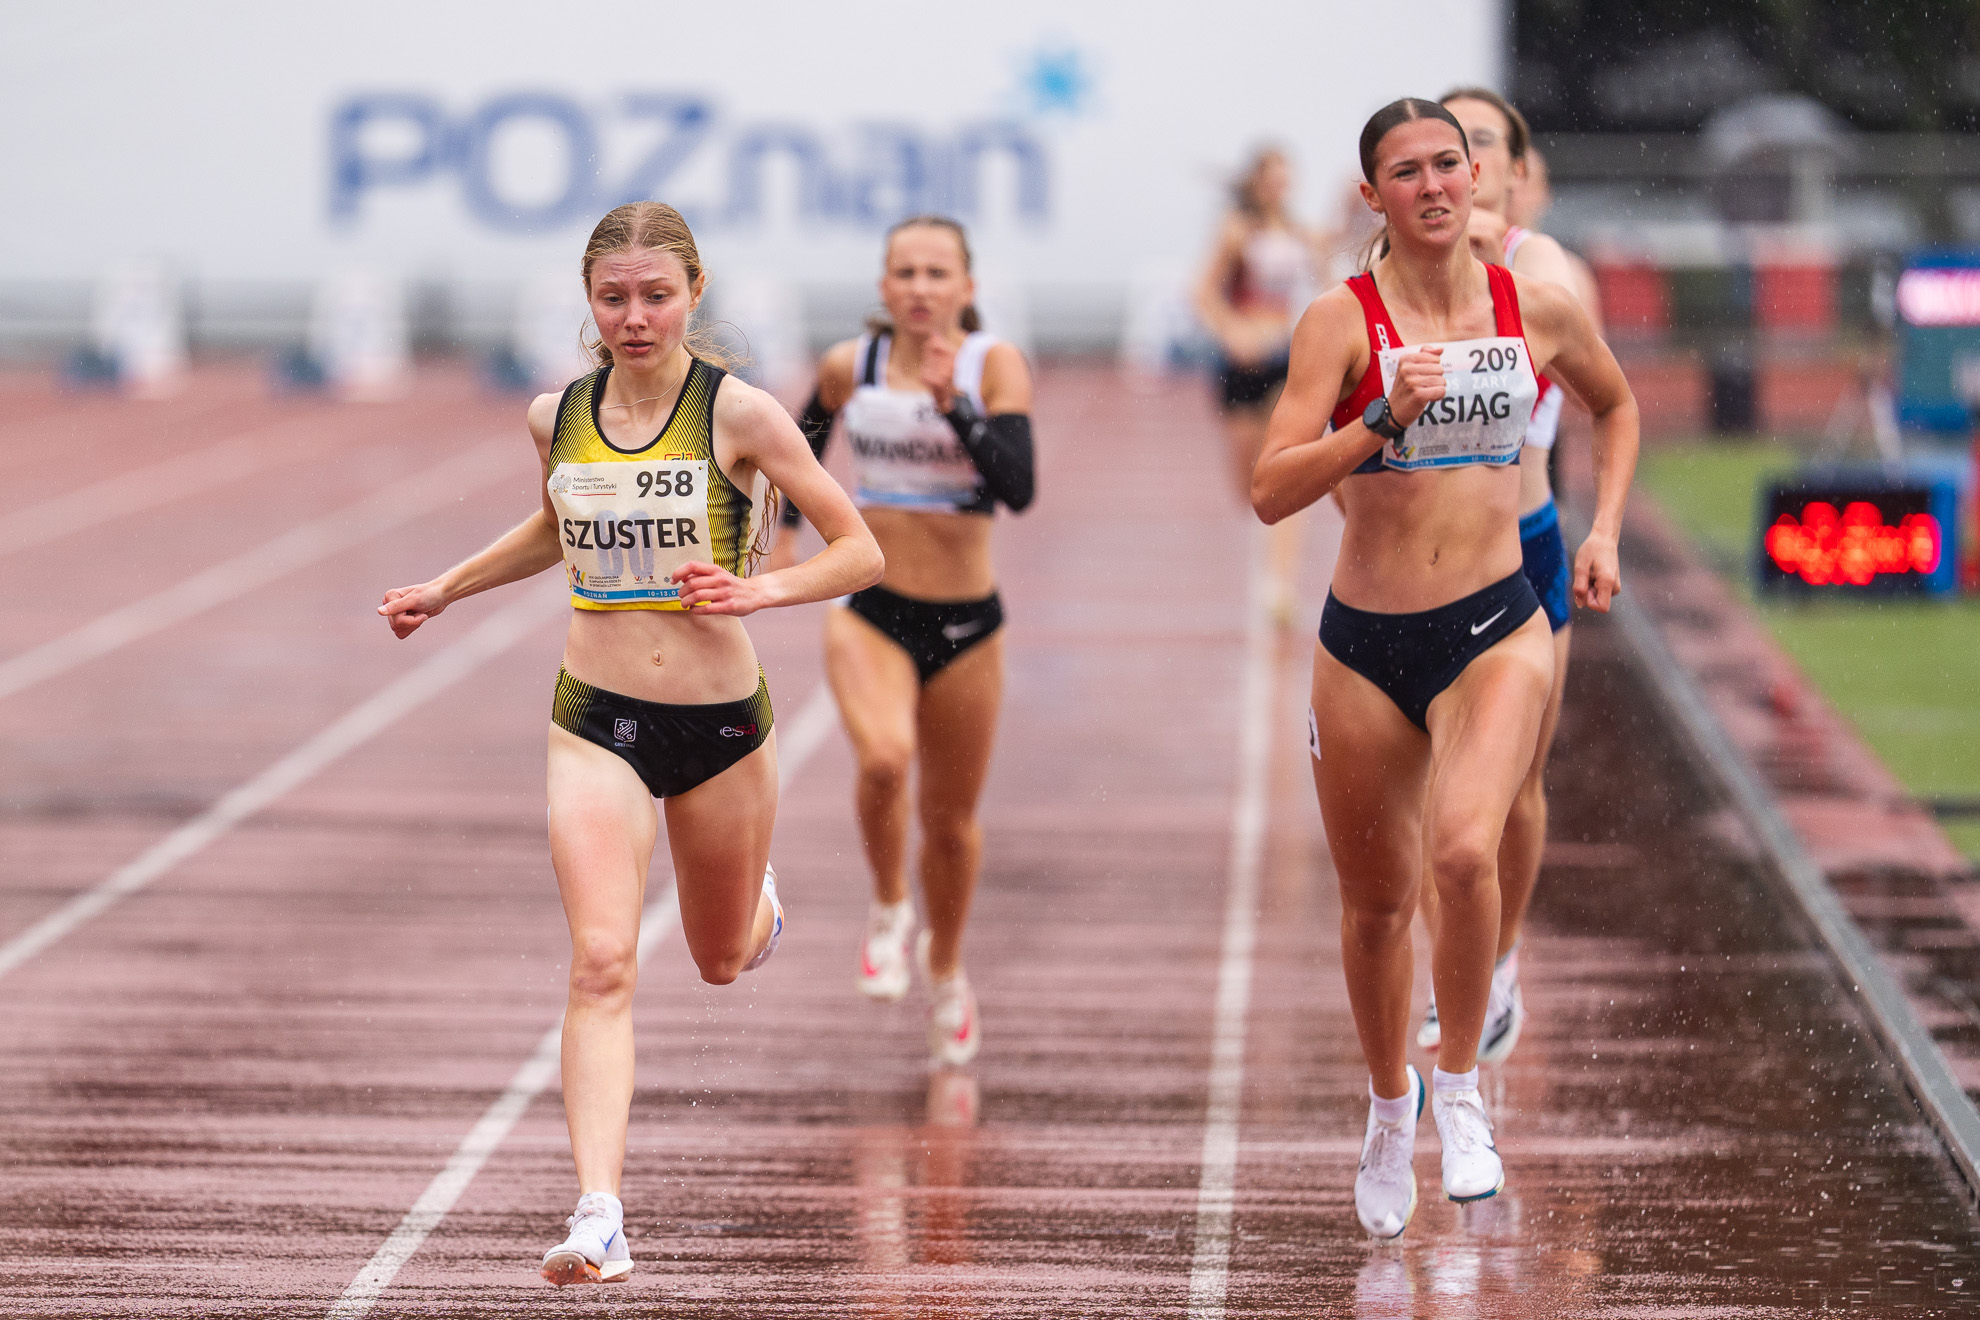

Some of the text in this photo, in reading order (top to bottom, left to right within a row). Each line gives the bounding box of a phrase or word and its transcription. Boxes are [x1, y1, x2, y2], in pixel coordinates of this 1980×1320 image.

[1469, 347, 1518, 374] 209
[636, 470, 694, 498] 958
[563, 518, 701, 550] SZUSTER
